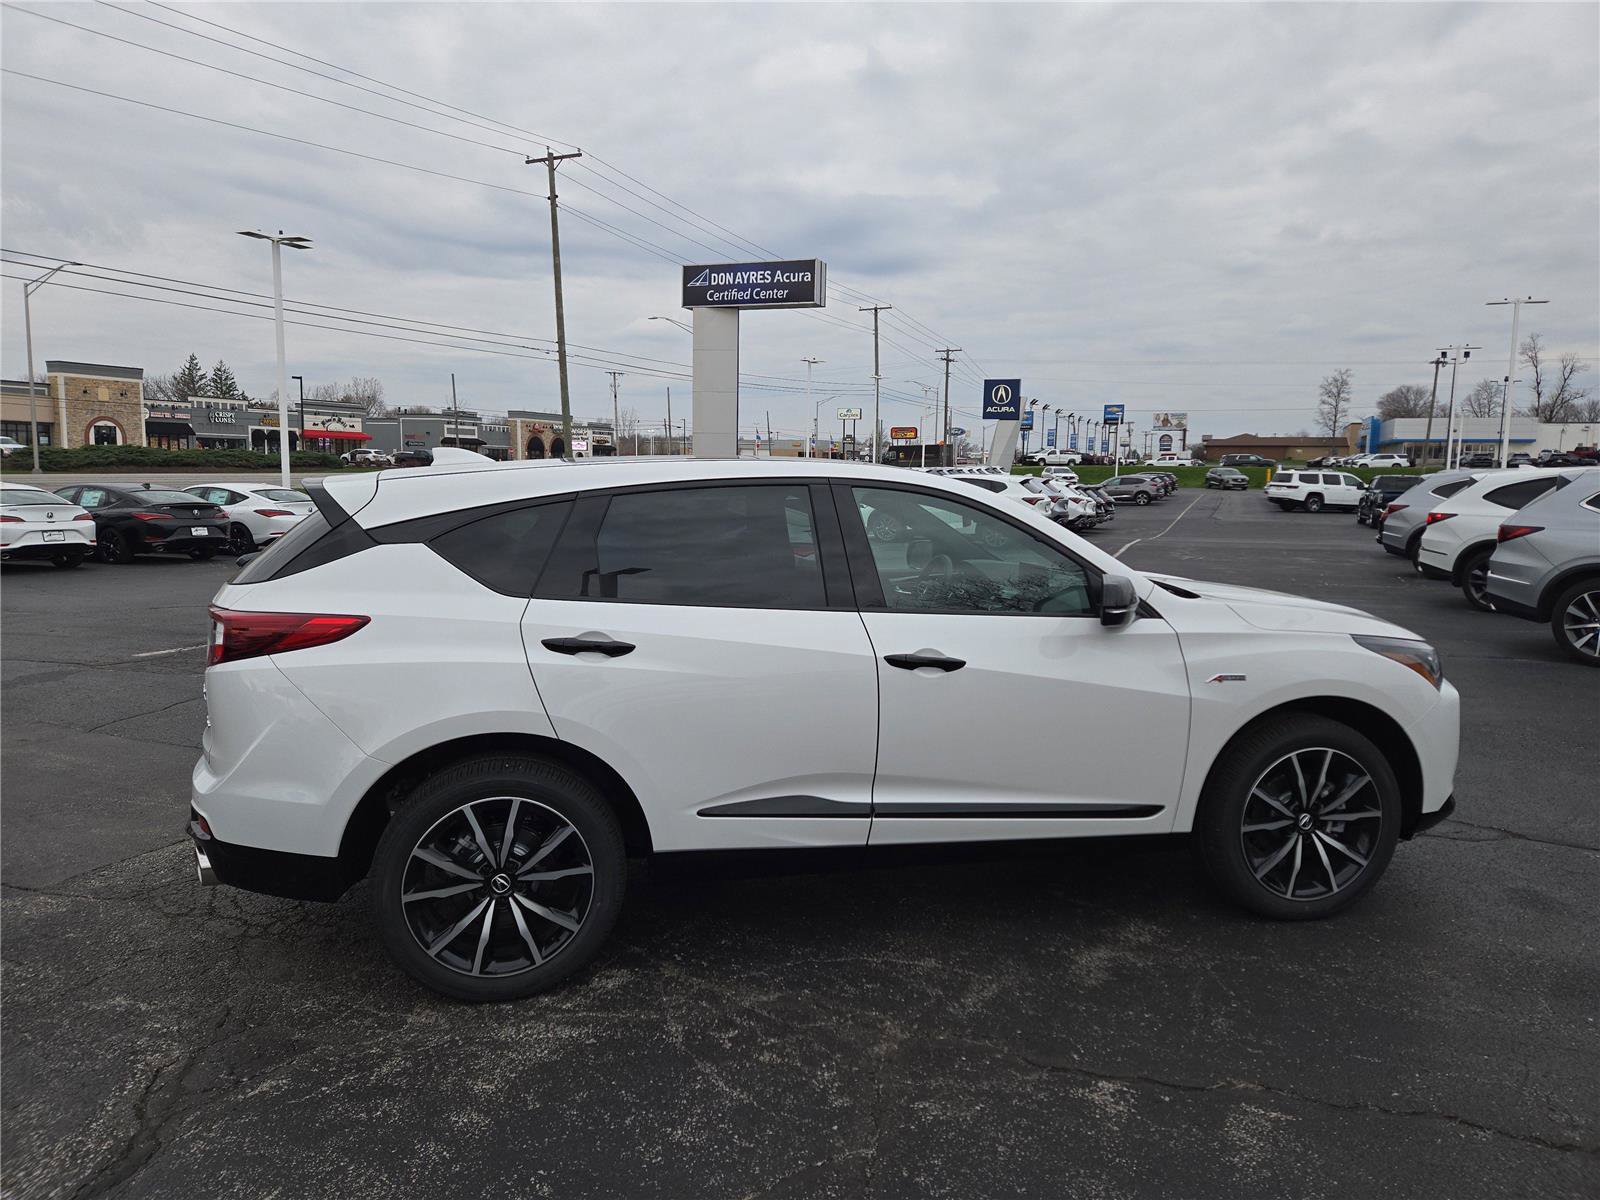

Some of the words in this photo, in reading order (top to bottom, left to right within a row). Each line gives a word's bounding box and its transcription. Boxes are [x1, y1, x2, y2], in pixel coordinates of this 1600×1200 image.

[711, 272, 734, 286] DON
[735, 270, 772, 284] AYRES
[773, 270, 812, 283] Acura
[706, 288, 751, 301] Certified
[752, 287, 789, 300] Center
